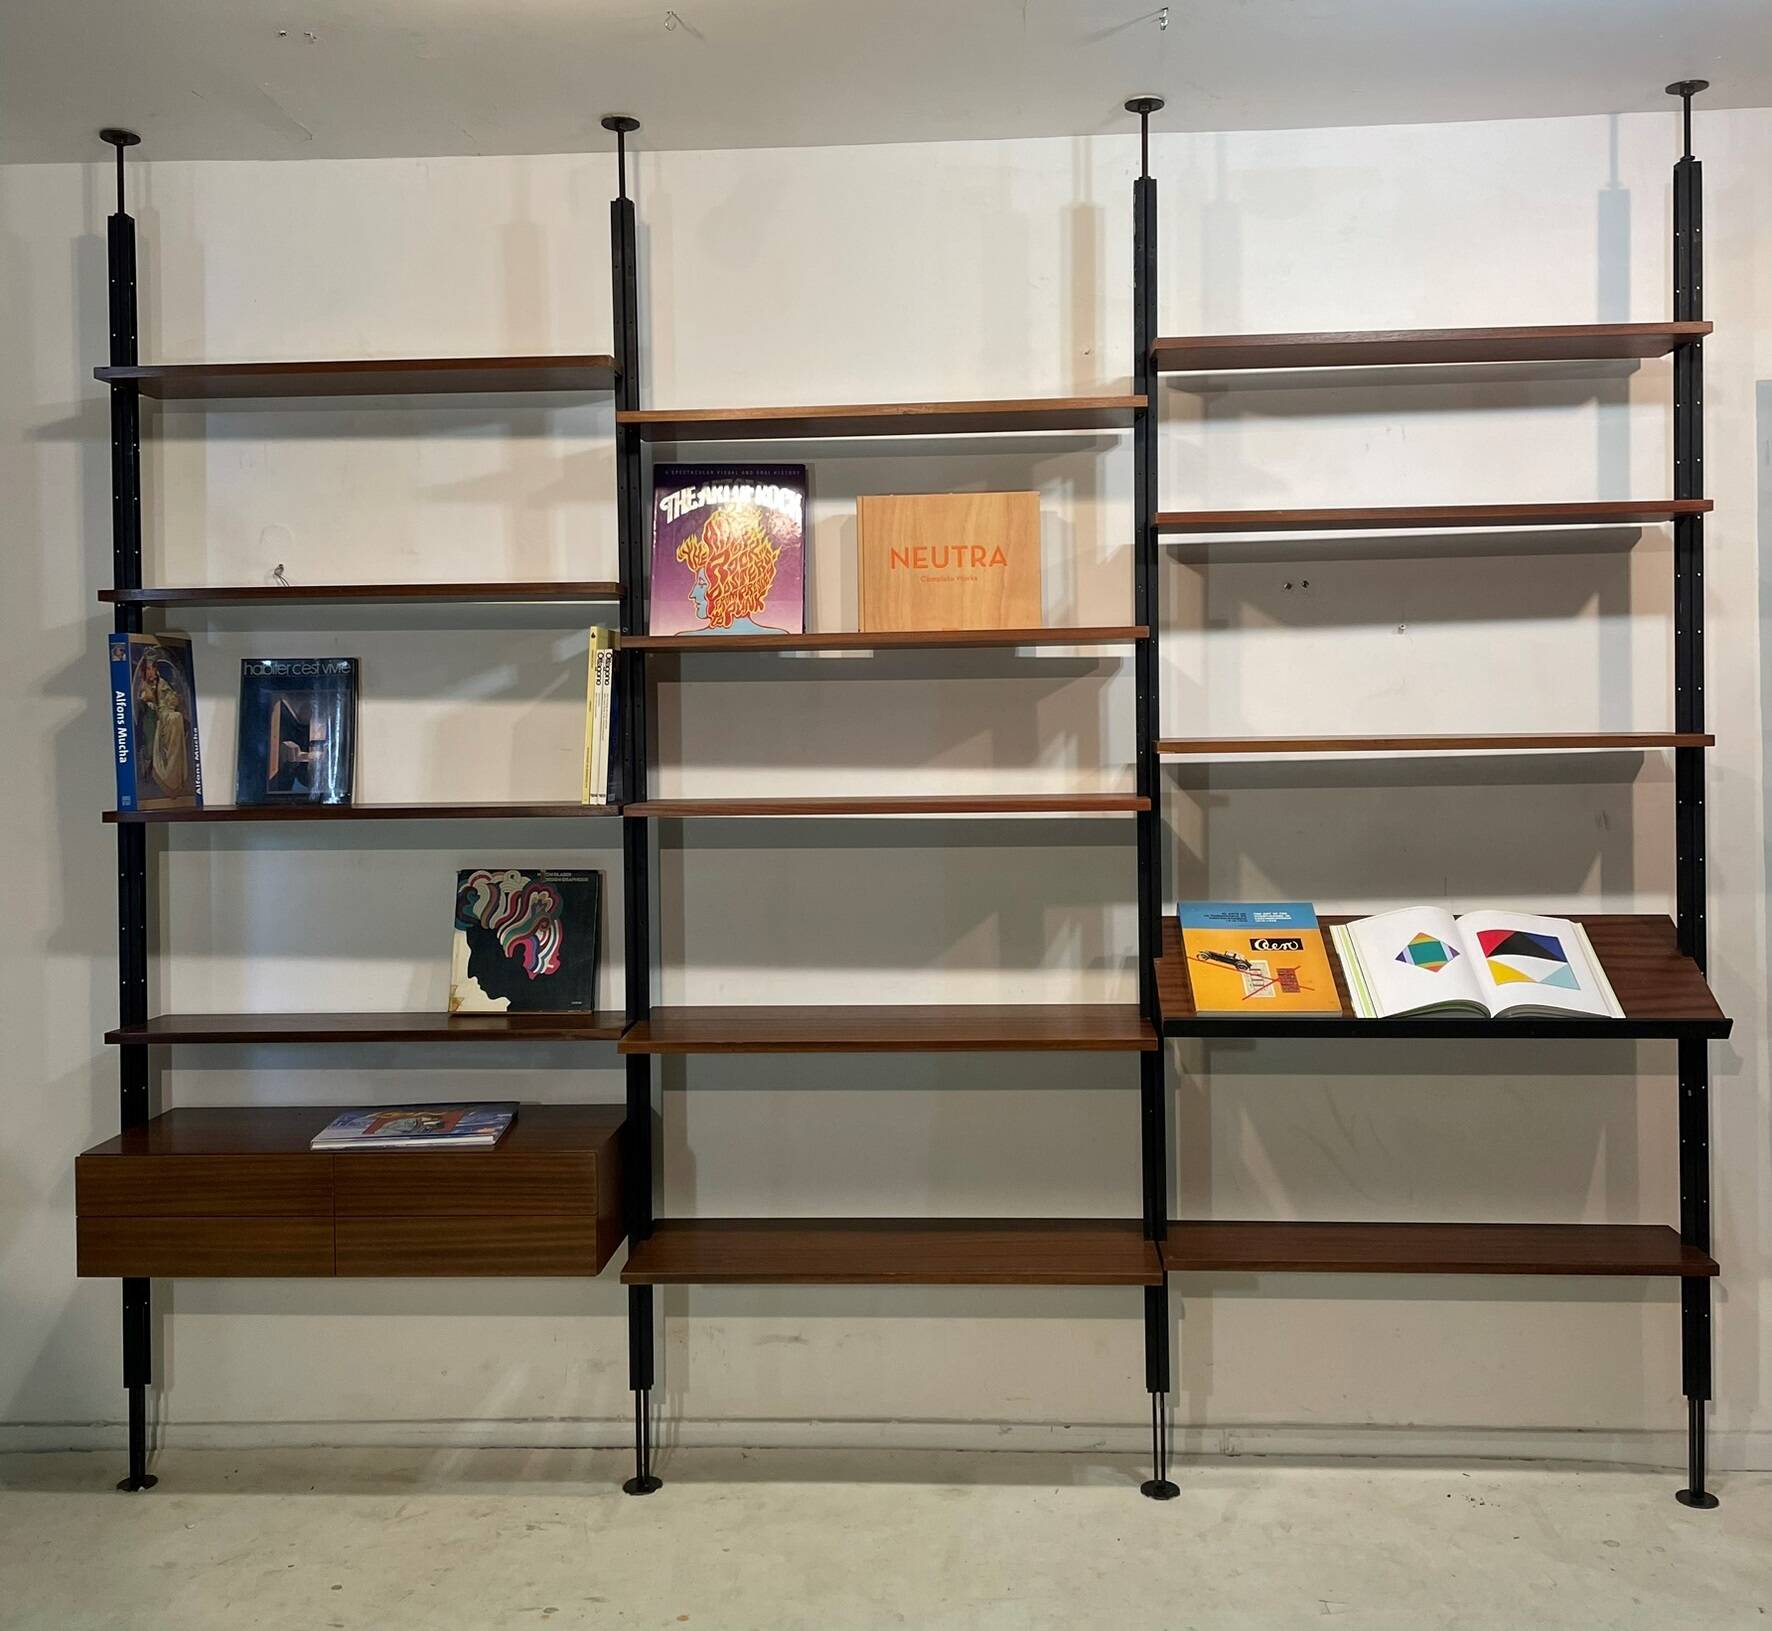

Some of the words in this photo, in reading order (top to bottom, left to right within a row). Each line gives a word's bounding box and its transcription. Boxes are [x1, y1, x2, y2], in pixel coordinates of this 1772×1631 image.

[659, 485, 698, 524] THE
[890, 544, 1008, 570] NEUTRA
[115, 690, 128, 725] Alfons
[117, 727, 129, 763] Mucha
[191, 763, 202, 795] Alfons
